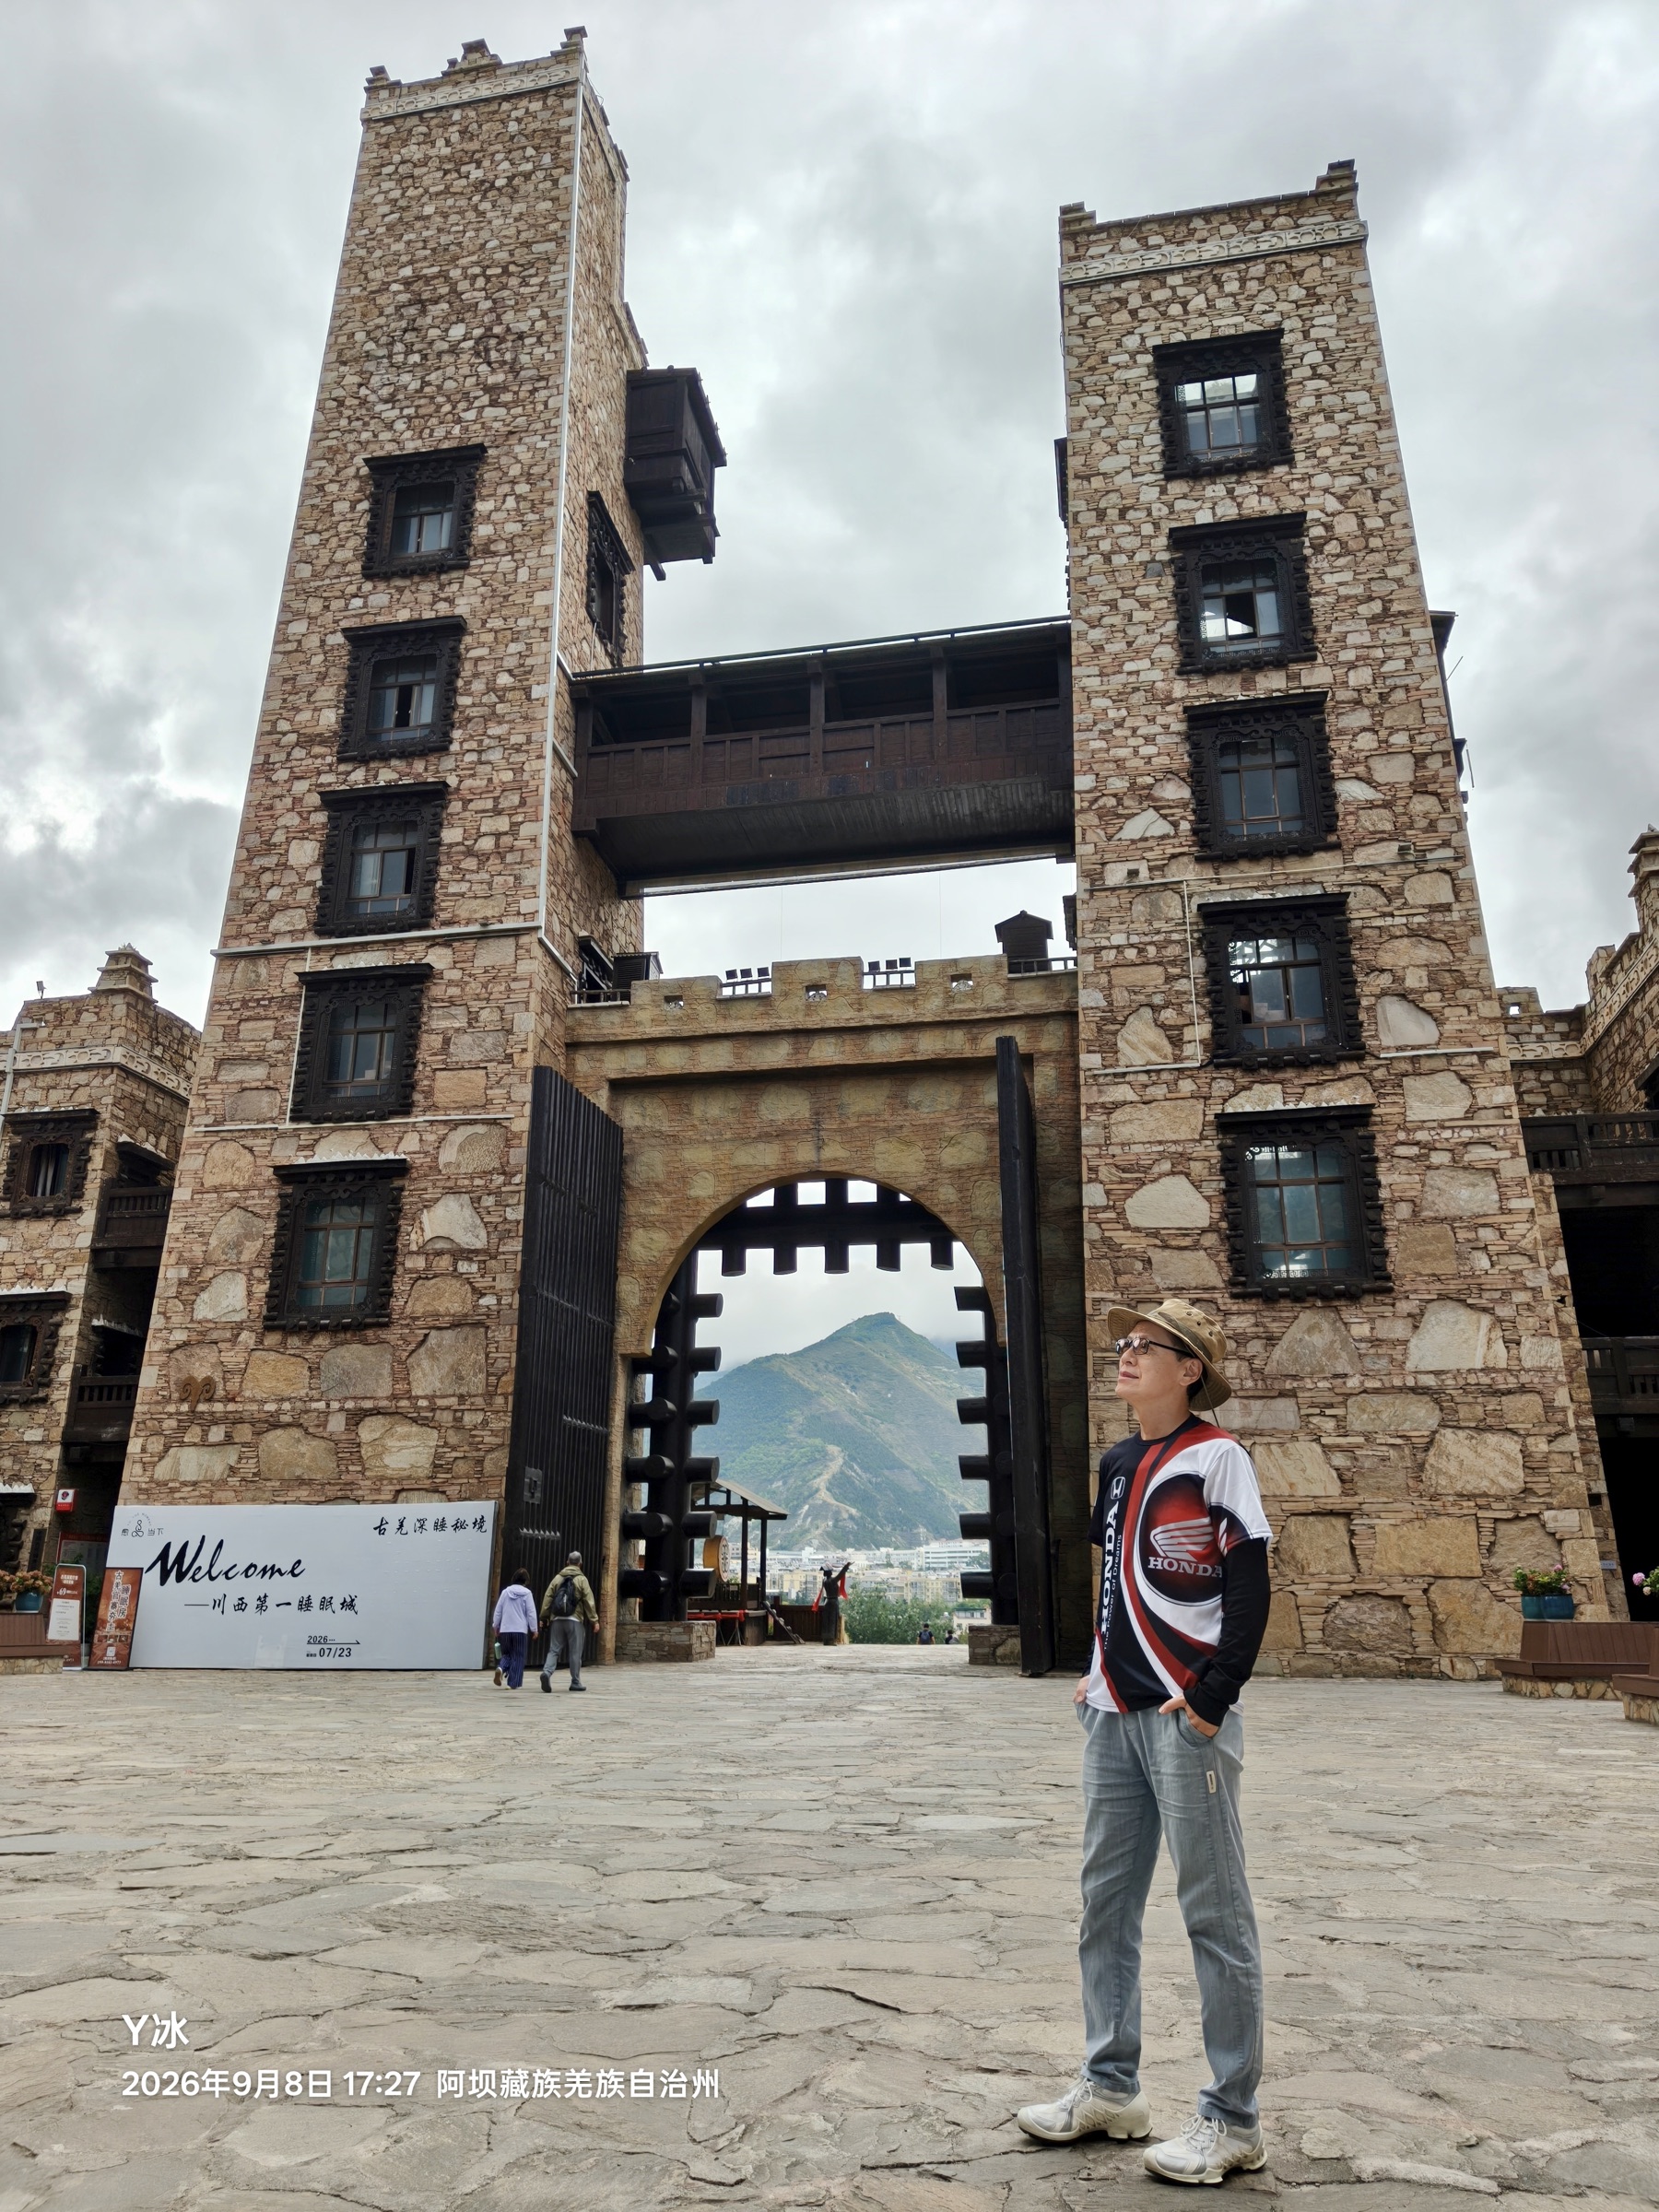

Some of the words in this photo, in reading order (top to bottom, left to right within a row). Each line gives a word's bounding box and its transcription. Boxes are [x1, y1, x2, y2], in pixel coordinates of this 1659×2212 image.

[372, 1514, 488, 1535] 古羌深睡秘境
[145, 1535, 306, 1586] Welcome
[1112, 1535, 1122, 1576] Dreams
[1101, 1501, 1119, 1635] HONDA
[1147, 1557, 1223, 1578] HONDA
[1112, 1579, 1116, 1591] of
[307, 1635, 328, 1643] 2026
[319, 1647, 352, 1658] 07/23
